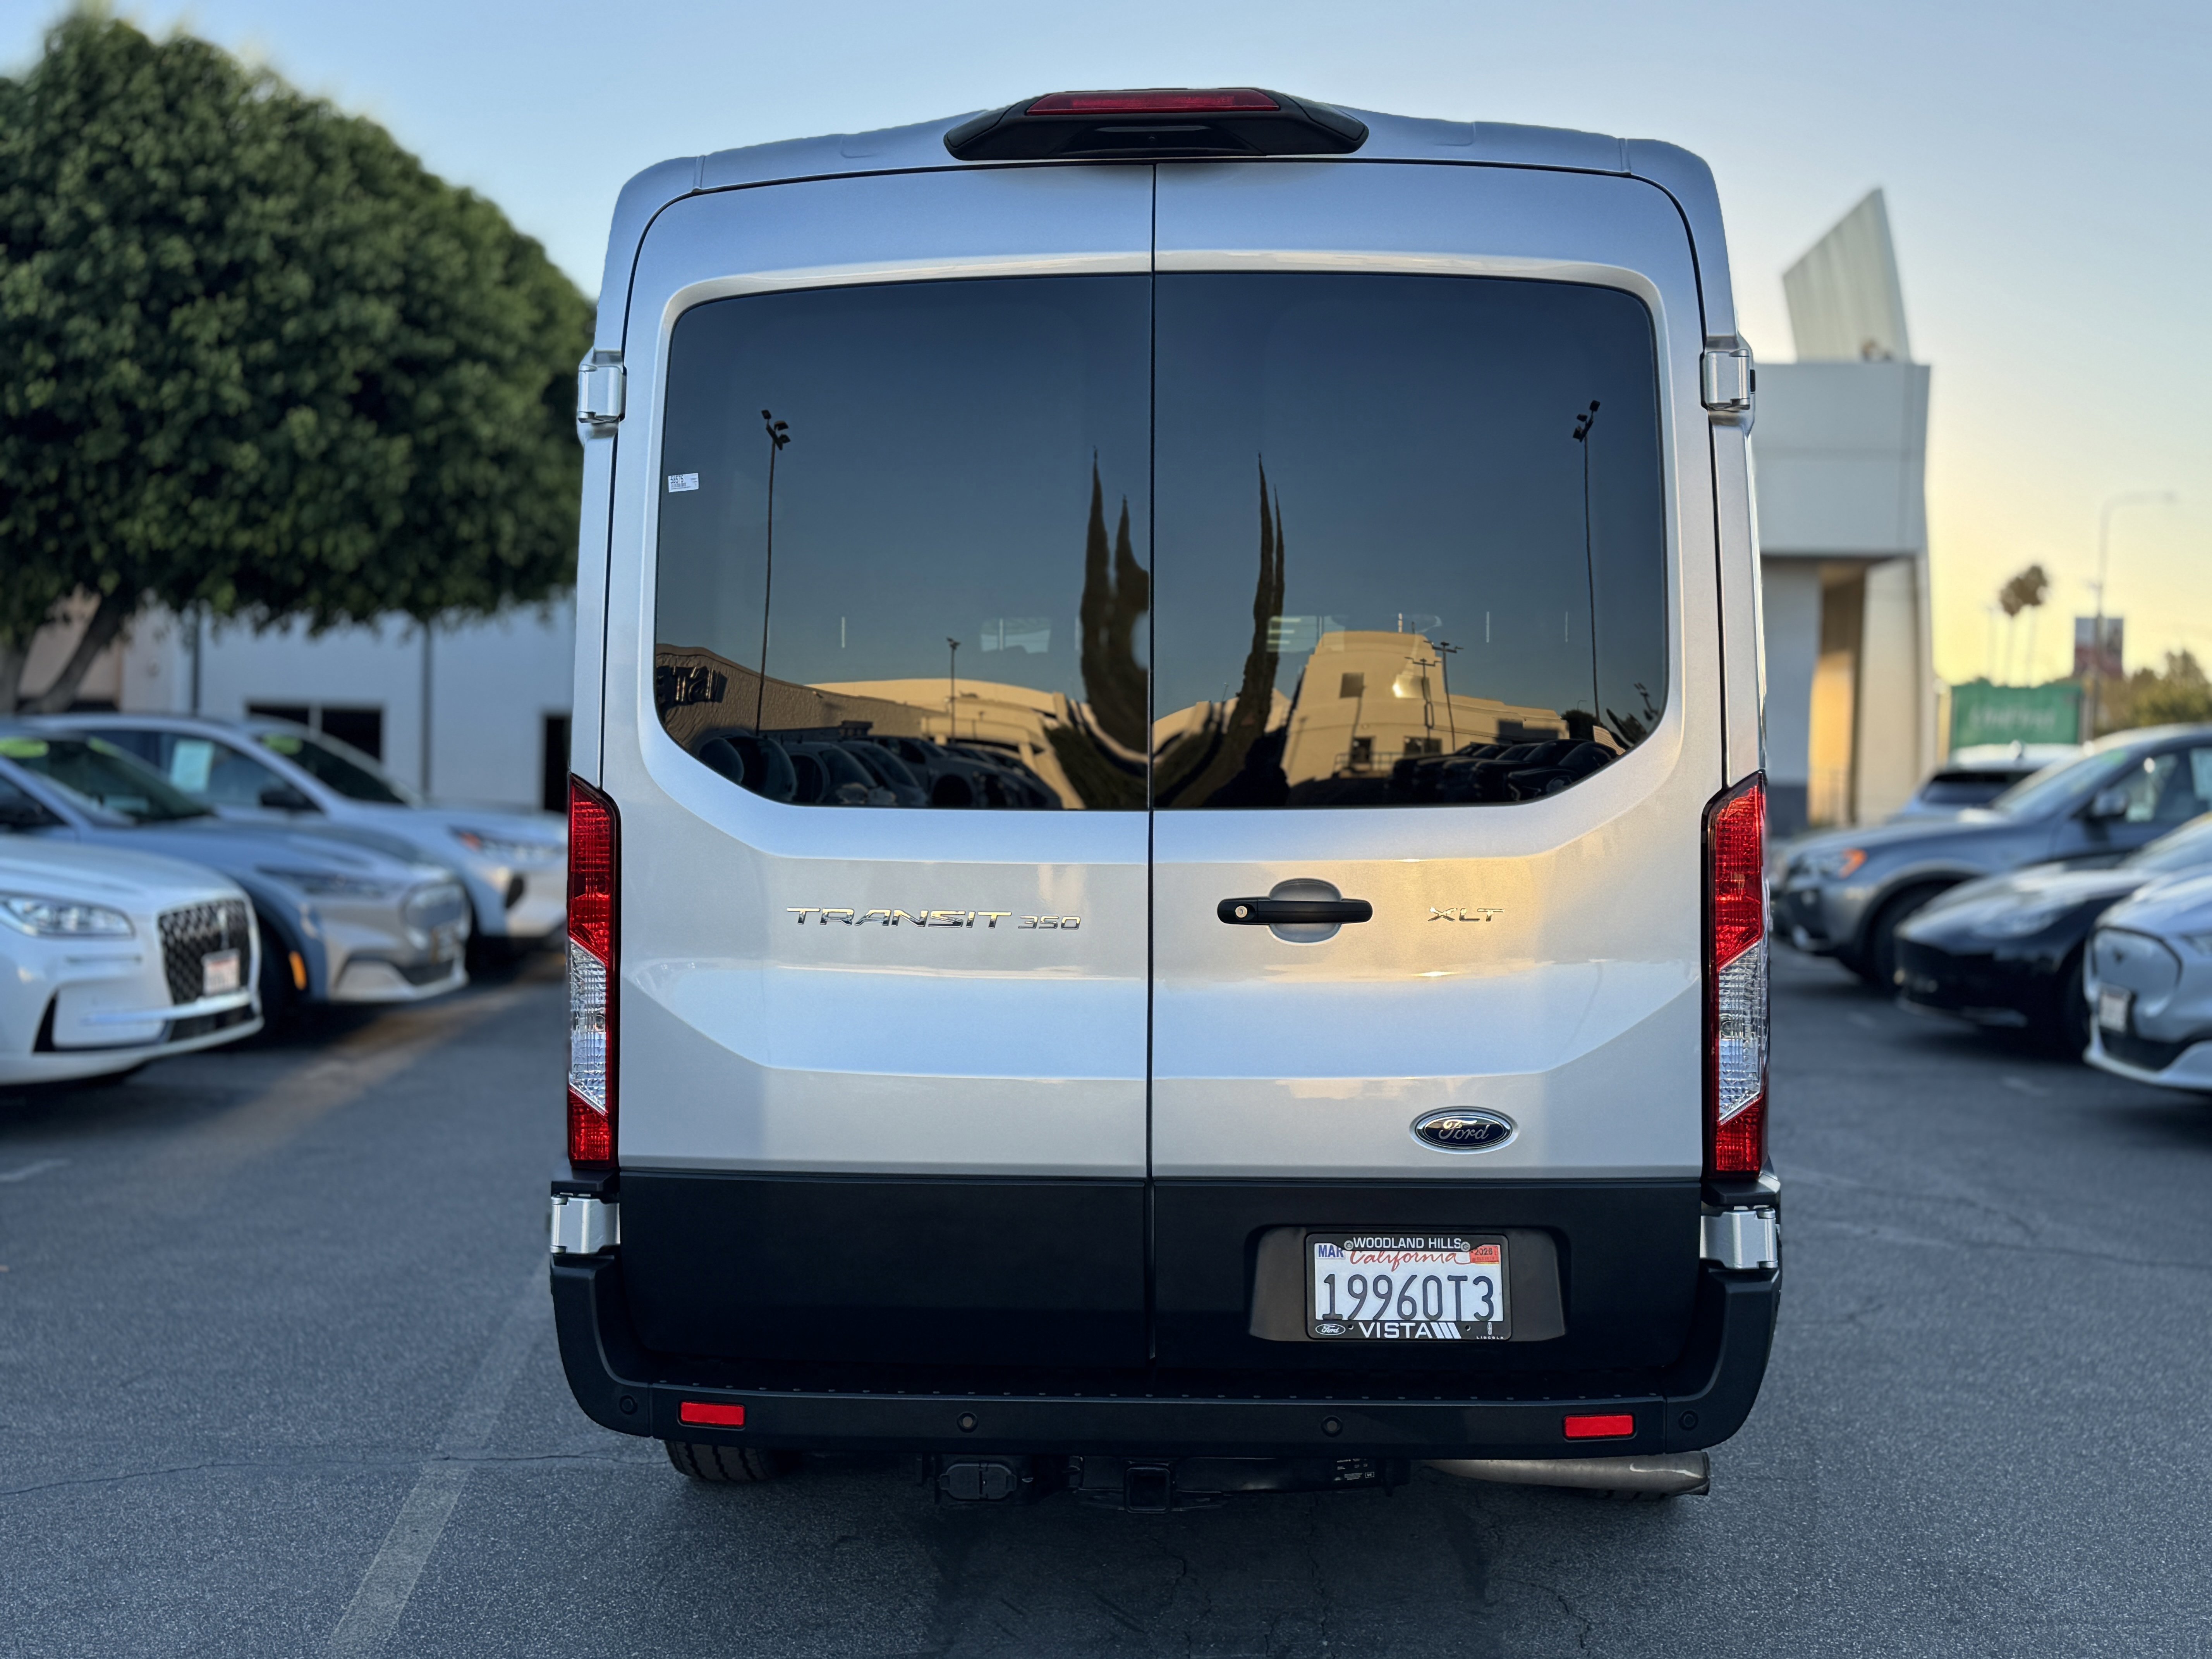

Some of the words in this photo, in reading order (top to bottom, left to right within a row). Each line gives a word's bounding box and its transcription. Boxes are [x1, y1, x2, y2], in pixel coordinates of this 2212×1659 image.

[787, 907, 1012, 929] TRANSIT
[1018, 915, 1081, 930] 350
[1428, 907, 1505, 922] XLT
[1438, 1119, 1489, 1140] Ford
[1319, 1245, 1344, 1258] MAR
[1353, 1237, 1424, 1249] WOODLAND
[1429, 1238, 1461, 1249] HILLS
[1350, 1250, 1471, 1272] California
[1322, 1273, 1494, 1321] 19960T3
[1358, 1322, 1432, 1338] VISTA
